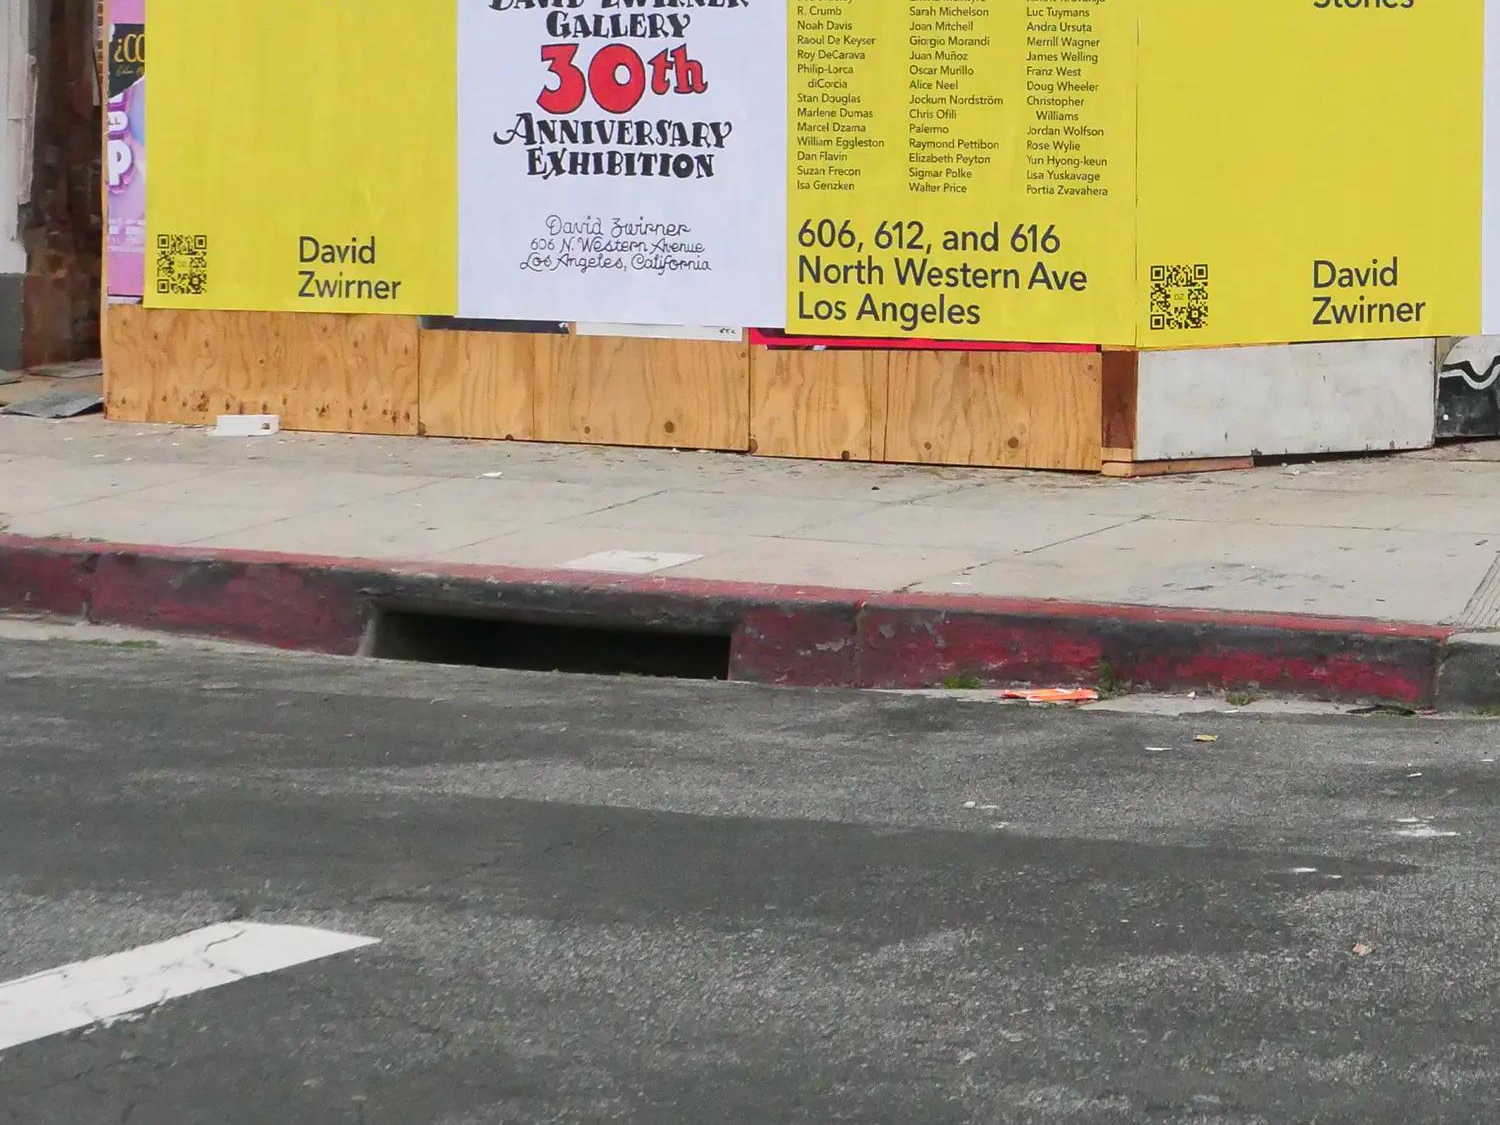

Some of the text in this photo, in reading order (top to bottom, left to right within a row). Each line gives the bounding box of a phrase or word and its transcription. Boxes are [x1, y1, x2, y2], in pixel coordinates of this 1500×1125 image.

[547, 11, 690, 38] GALLERY
[536, 44, 708, 114] 30th
[910, 81, 958, 90] Alice Neel
[493, 113, 732, 148] ANNIVERSARY
[527, 146, 714, 180] EXHIBITION
[797, 152, 847, 161] Dan Flavin
[546, 214, 691, 238] David Zwirner
[799, 219, 1060, 254] 606, 612, and 616
[300, 236, 375, 264] David
[531, 238, 555, 251] 606
[578, 237, 648, 252] Western
[649, 238, 705, 255] Avenue
[520, 252, 711, 275] Los Angeles, California
[799, 255, 1087, 291] North Western Ave
[1314, 257, 1397, 288] David
[298, 271, 401, 299] Zwirner
[799, 291, 980, 331] Los Angeles
[1313, 295, 1425, 324] Zwirner
